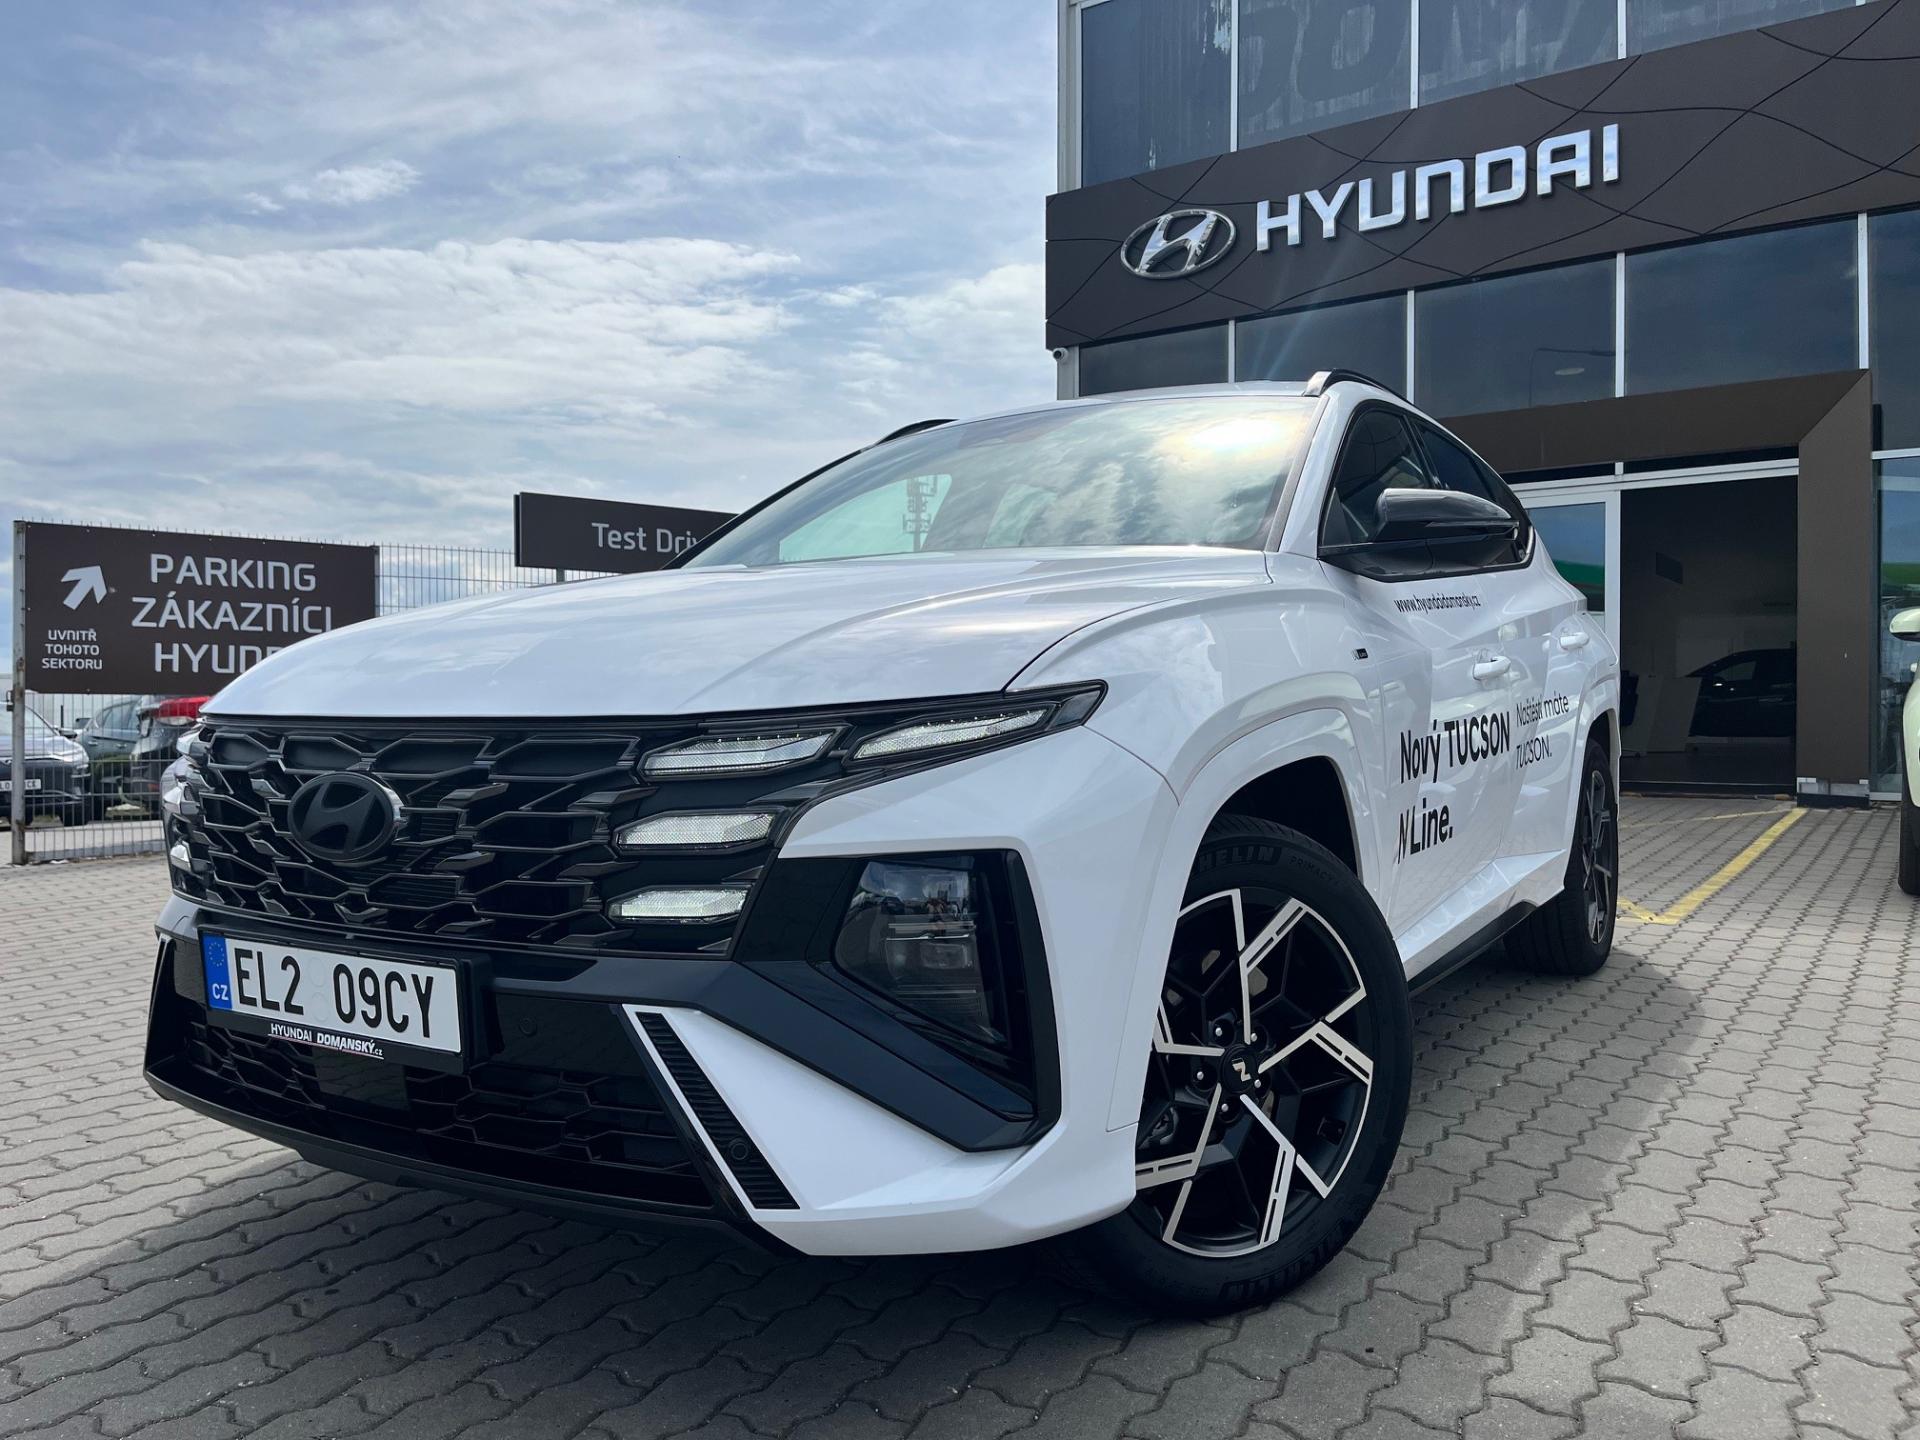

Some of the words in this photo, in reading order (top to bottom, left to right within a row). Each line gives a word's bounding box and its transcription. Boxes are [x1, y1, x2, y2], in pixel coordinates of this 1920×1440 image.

[1256, 124, 1620, 252] HYUNDAI
[592, 522, 647, 551] Test
[657, 528, 698, 553] Dri
[150, 553, 316, 592] PARKING
[131, 591, 331, 634] ZÁKAZNÍCI
[45, 643, 100, 656] TOHOTO
[48, 628, 97, 642] UVNITŘ
[41, 657, 103, 670] SEKTORU
[154, 642, 283, 674] HYUN
[1400, 719, 1441, 784] Nový
[1444, 711, 1511, 768] TUCSON
[1516, 734, 1553, 769] TUCSON.
[212, 983, 229, 1001] CZ
[234, 948, 304, 1016] EL2
[333, 963, 434, 1038] 09CY
[270, 1023, 312, 1042] HYUNDAI
